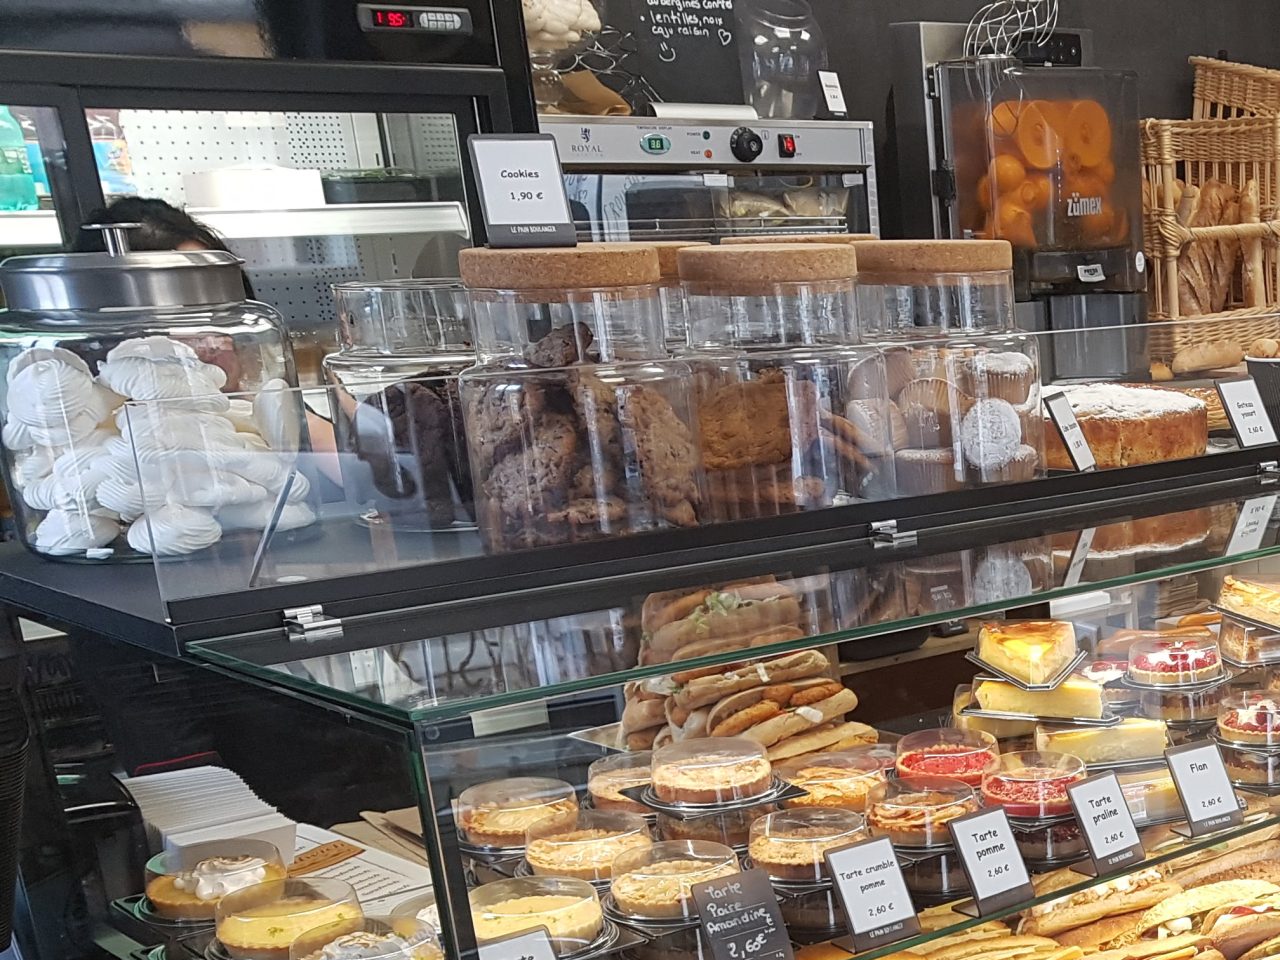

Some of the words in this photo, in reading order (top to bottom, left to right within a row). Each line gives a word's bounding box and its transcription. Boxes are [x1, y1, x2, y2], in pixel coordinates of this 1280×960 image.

[678, 26, 709, 37] raisin
[571, 145, 602, 153] ROYAL
[500, 169, 540, 178] Cookies
[510, 192, 533, 201] 1,90
[536, 192, 544, 200] €
[1067, 192, 1102, 216] zümex
[1190, 763, 1208, 774] Flan
[1088, 795, 1112, 809] Tarte
[1092, 808, 1119, 826] praline
[971, 829, 999, 843] Tarte
[976, 842, 1006, 862] pomme
[839, 869, 863, 881] Tarte
[865, 859, 895, 875] crumble
[987, 866, 1003, 878] 2,60
[859, 879, 886, 895] pomme
[706, 902, 744, 918] Poire
[868, 905, 887, 917] 2,60
[706, 907, 768, 935] Amandine
